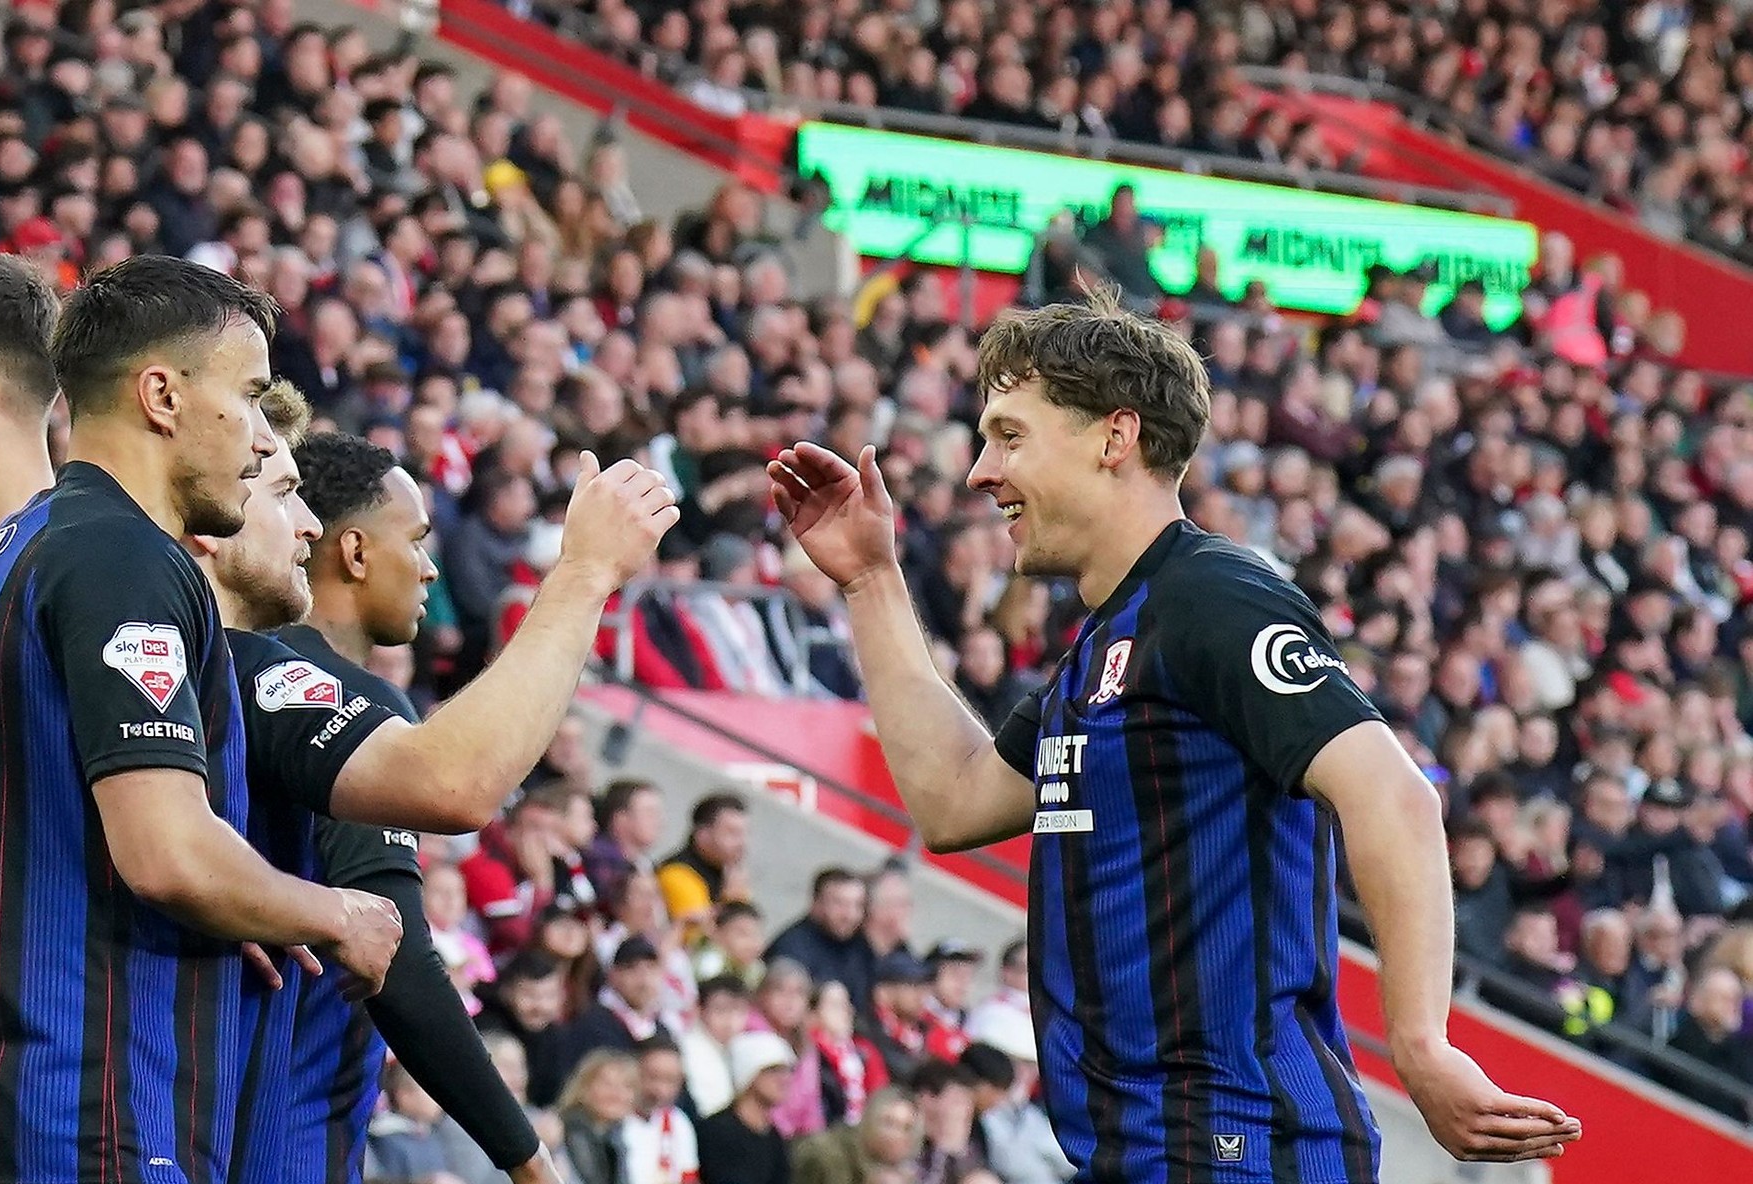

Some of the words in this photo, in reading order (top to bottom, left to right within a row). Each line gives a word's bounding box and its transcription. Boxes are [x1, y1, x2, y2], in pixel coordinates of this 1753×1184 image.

[115, 640, 139, 654] sky
[146, 641, 168, 653] bet
[119, 721, 196, 743] TOGETHER
[310, 696, 371, 750] TOGETHER
[1037, 735, 1088, 777] UNIBET
